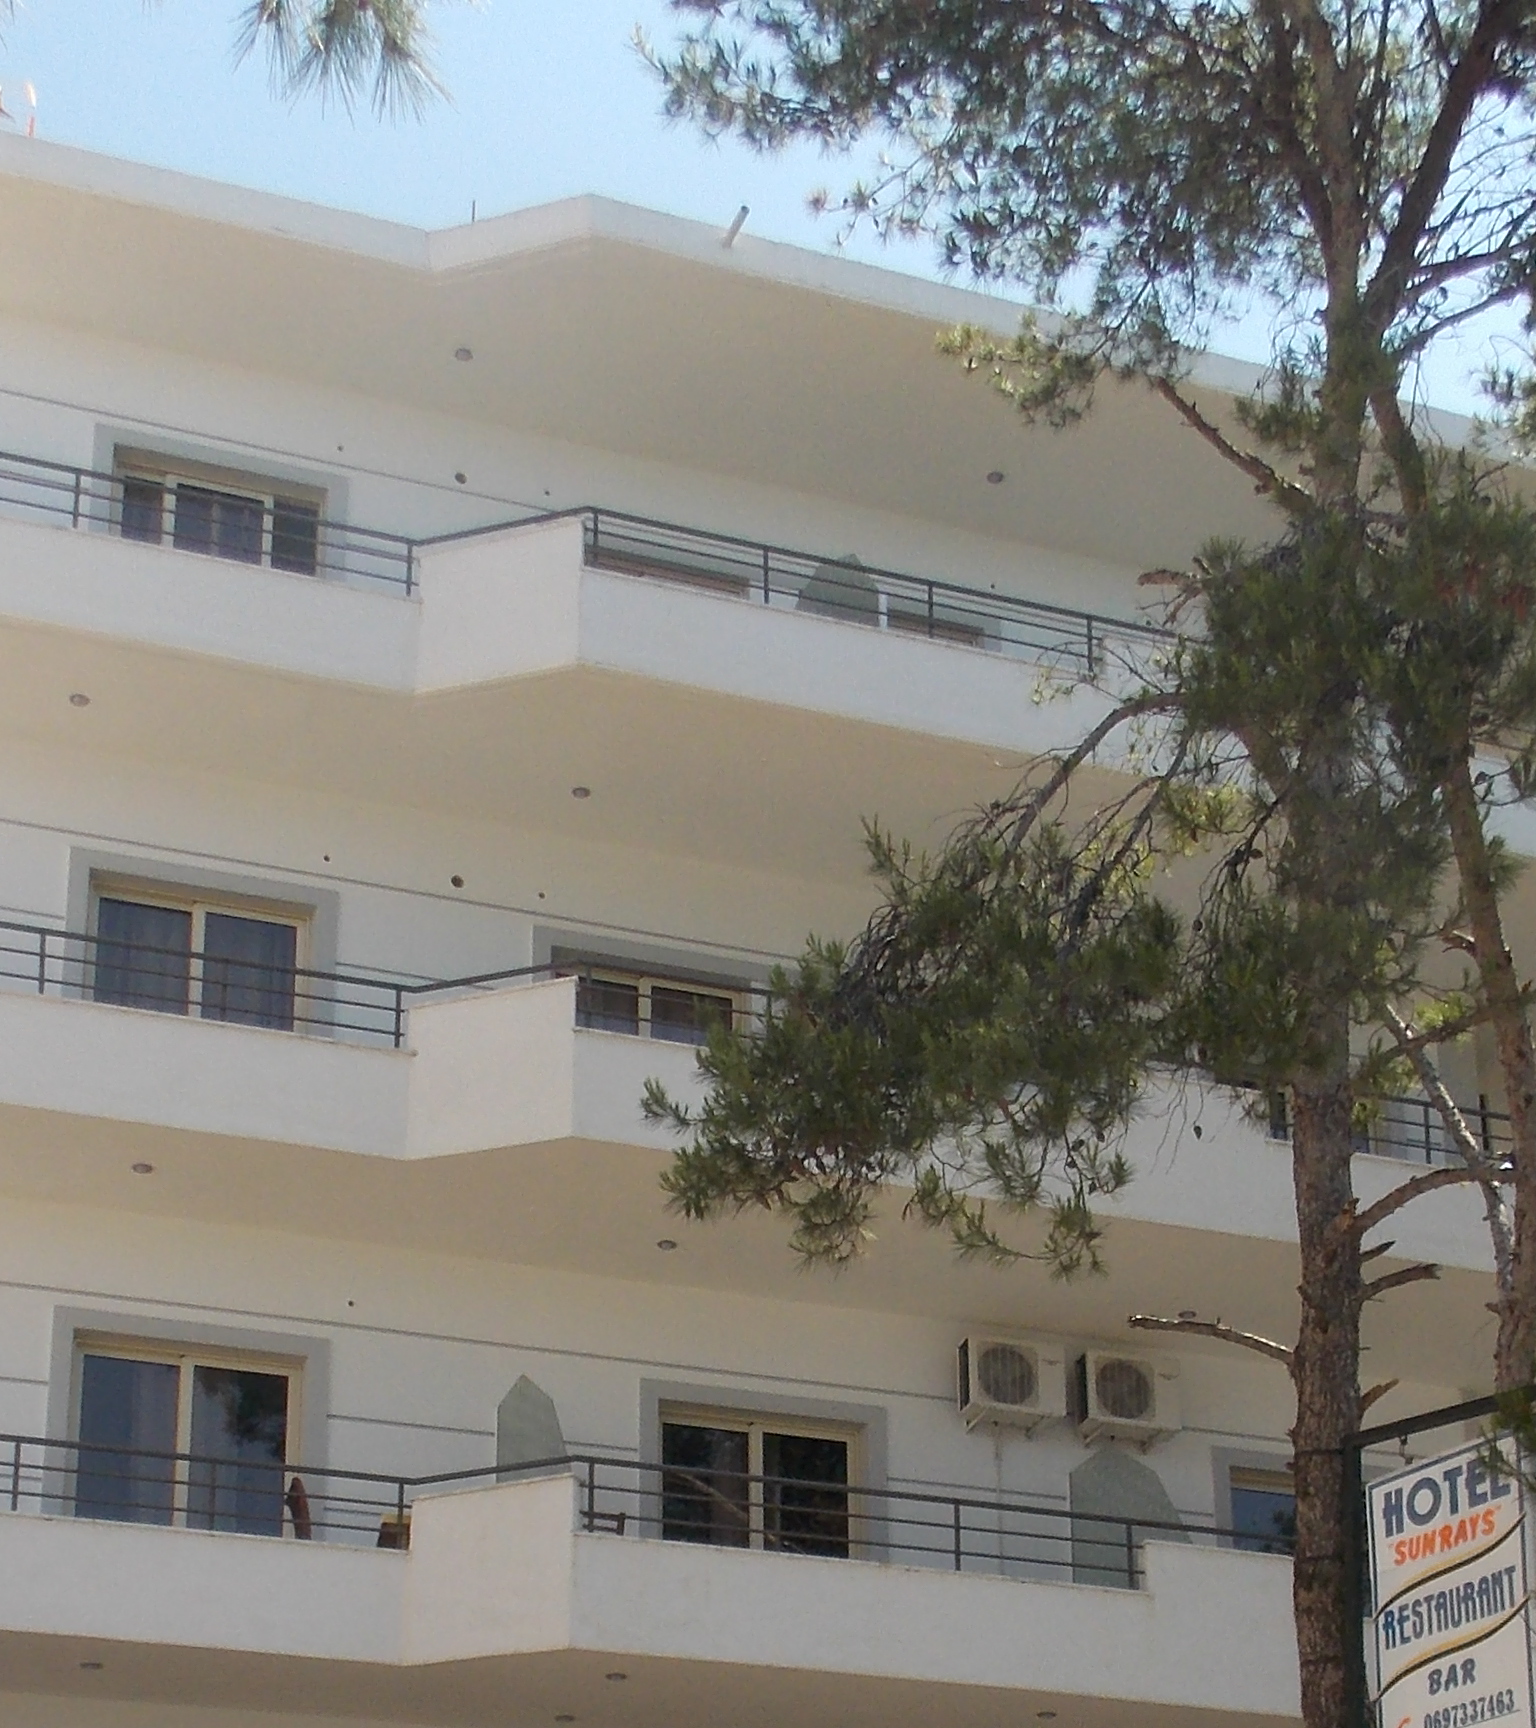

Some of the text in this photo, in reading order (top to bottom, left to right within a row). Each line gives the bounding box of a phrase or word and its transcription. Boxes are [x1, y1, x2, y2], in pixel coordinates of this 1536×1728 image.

[1382, 1454, 1512, 1539] HOTEL
[1382, 1565, 1517, 1650] RESTAURANT
[1427, 1658, 1476, 1696] BAR
